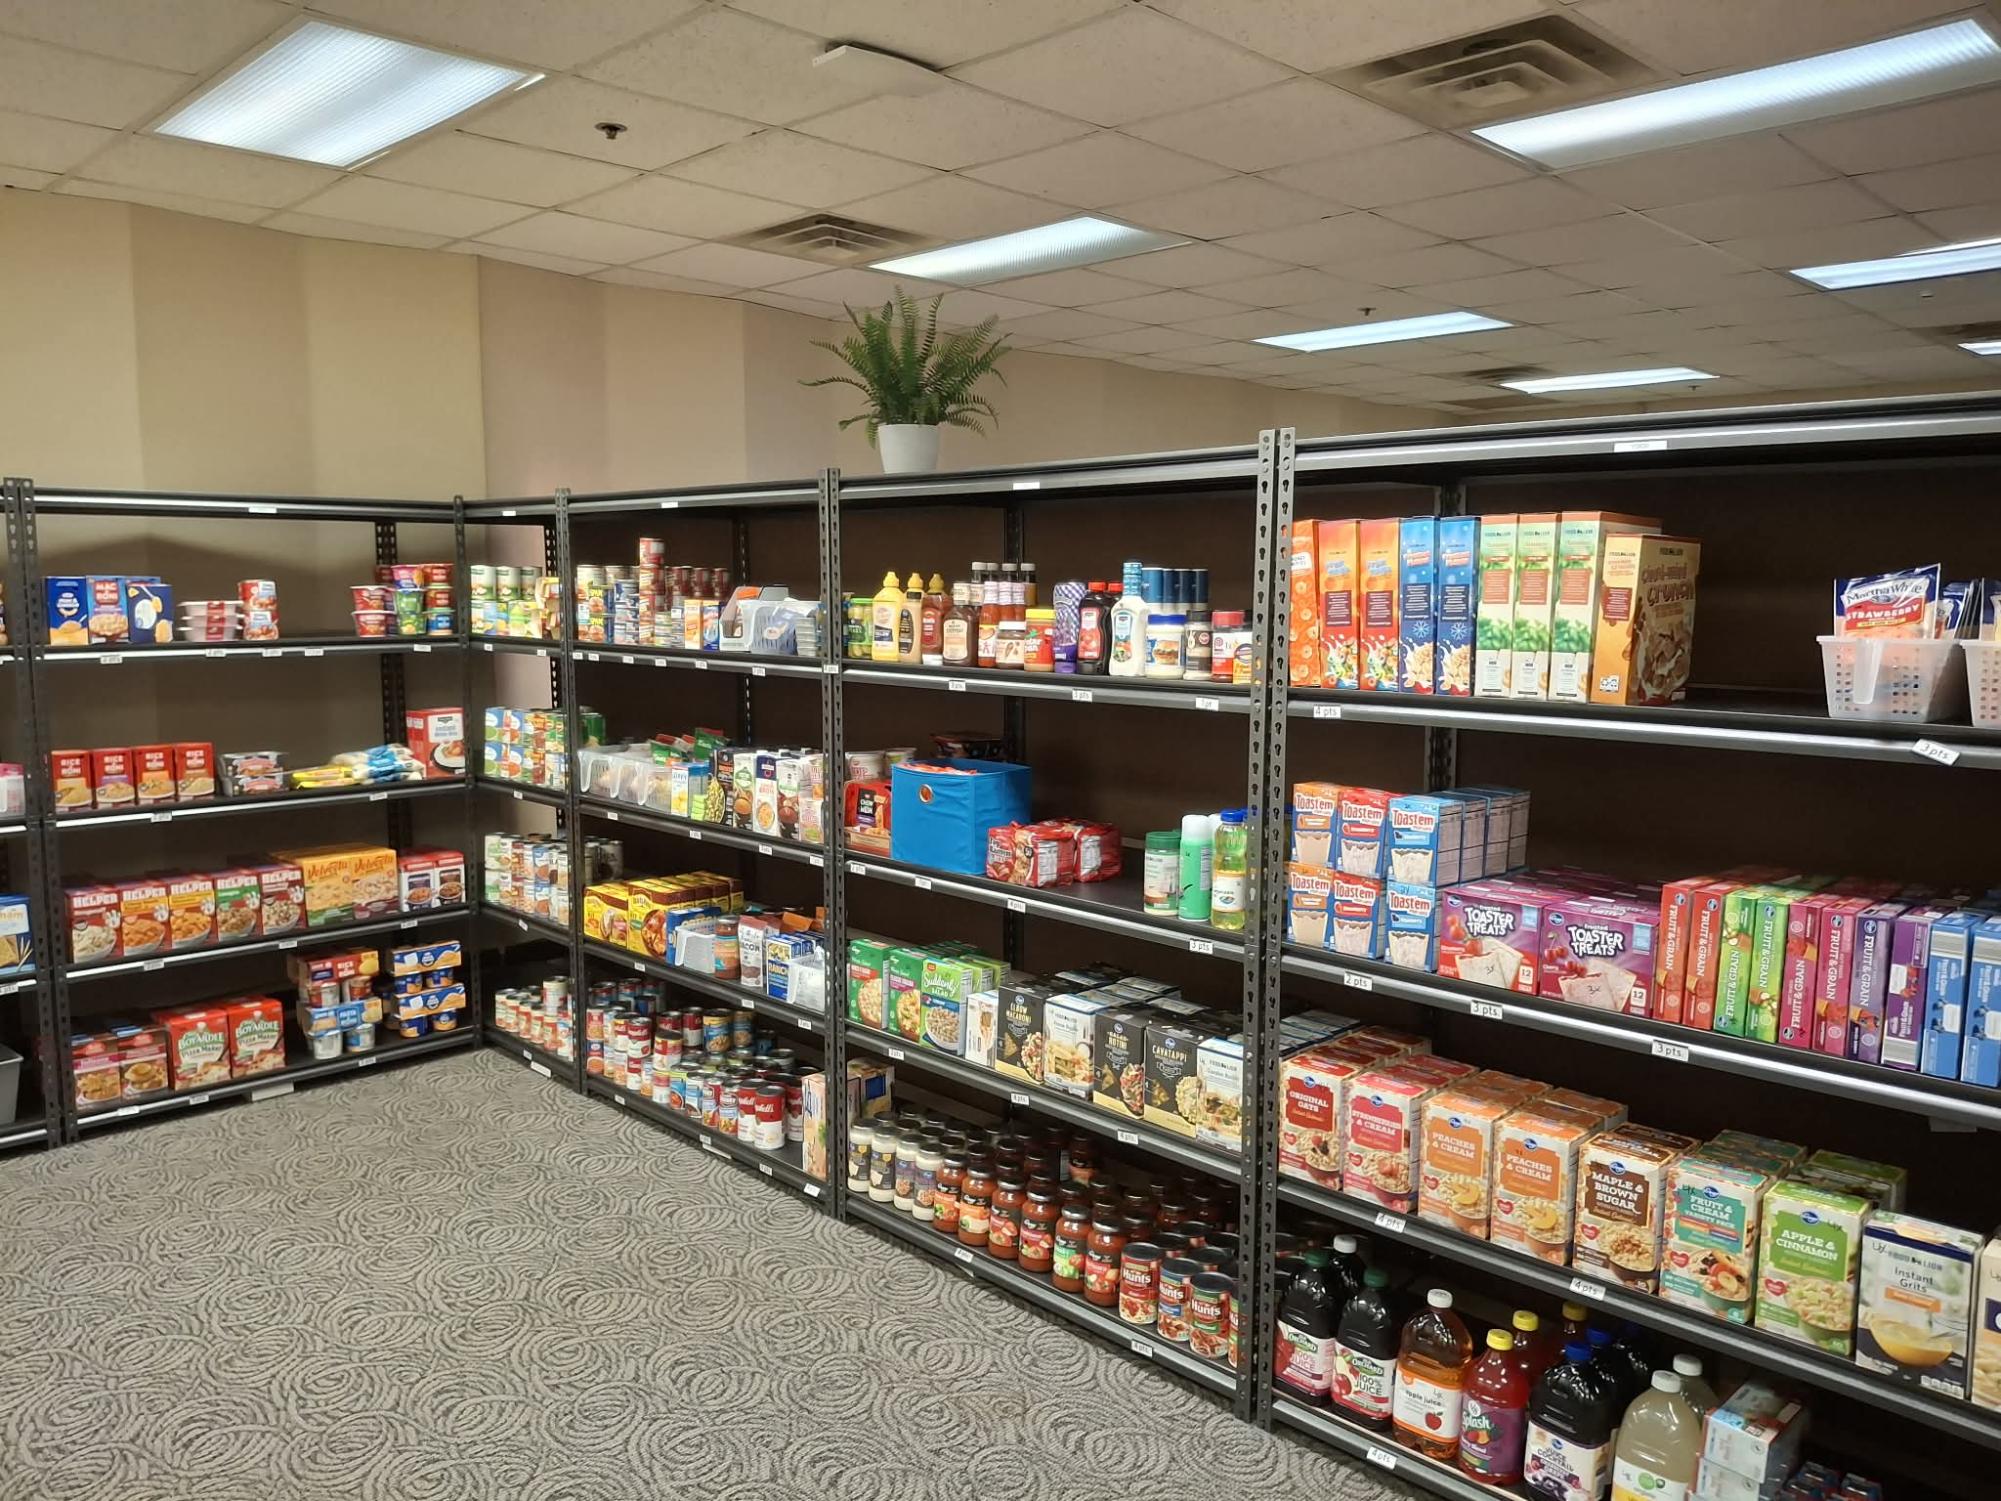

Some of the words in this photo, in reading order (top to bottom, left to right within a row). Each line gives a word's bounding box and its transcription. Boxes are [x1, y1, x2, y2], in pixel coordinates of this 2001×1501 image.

[1847, 588, 1890, 604] Martha
[1846, 604, 1920, 620] STRAWBERRY
[1323, 707, 1336, 716] pts
[1922, 744, 1930, 752] 3
[1930, 746, 1948, 760] pts
[1464, 906, 1515, 930] TOASTER
[1466, 922, 1506, 936] TREATS
[1568, 926, 1624, 950] TOASTER
[1198, 942, 1209, 951] pts
[1571, 942, 1616, 956] TREATS
[1521, 968, 1531, 977] 12
[1352, 978, 1366, 988] pts
[1633, 991, 1644, 1000] 12
[1472, 1002, 1480, 1012] 3
[1152, 1045, 1187, 1062] CAVATAPPI
[1656, 1043, 1662, 1051] 3
[1664, 1046, 1680, 1056] pts
[1290, 1090, 1328, 1108] ORIGINAL
[1298, 1102, 1319, 1112] OATS
[1364, 1121, 1396, 1136] CREAM
[1432, 1132, 1476, 1150] PEACHES
[1440, 1142, 1474, 1158] CREAM
[1506, 1154, 1552, 1173] PEACHES
[1515, 1164, 1552, 1182] CREAM
[1592, 1172, 1633, 1190] MAPLE
[1634, 1184, 1644, 1193] &
[1594, 1182, 1638, 1201] BROWN
[1596, 1192, 1642, 1214] SUGAR
[1690, 1196, 1724, 1210] FRUIT
[1724, 1206, 1732, 1214] &
[1690, 1204, 1730, 1220] CREAM
[1386, 1217, 1400, 1228] pts
[1782, 1230, 1824, 1248] APPLE
[1825, 1242, 1835, 1250] &
[1776, 1238, 1838, 1261] CINNAMON
[1894, 1266, 1934, 1286] Instant
[1582, 1284, 1597, 1294] pts
[1900, 1278, 1928, 1293] Grits
[1354, 1381, 1382, 1395] JUICE
[1360, 1374, 1382, 1388] 100%
[1406, 1390, 1422, 1400] apple
[1424, 1398, 1442, 1406] juice
[1376, 1452, 1389, 1462] pts
[1538, 1449, 1574, 1472] COCKTAIL
